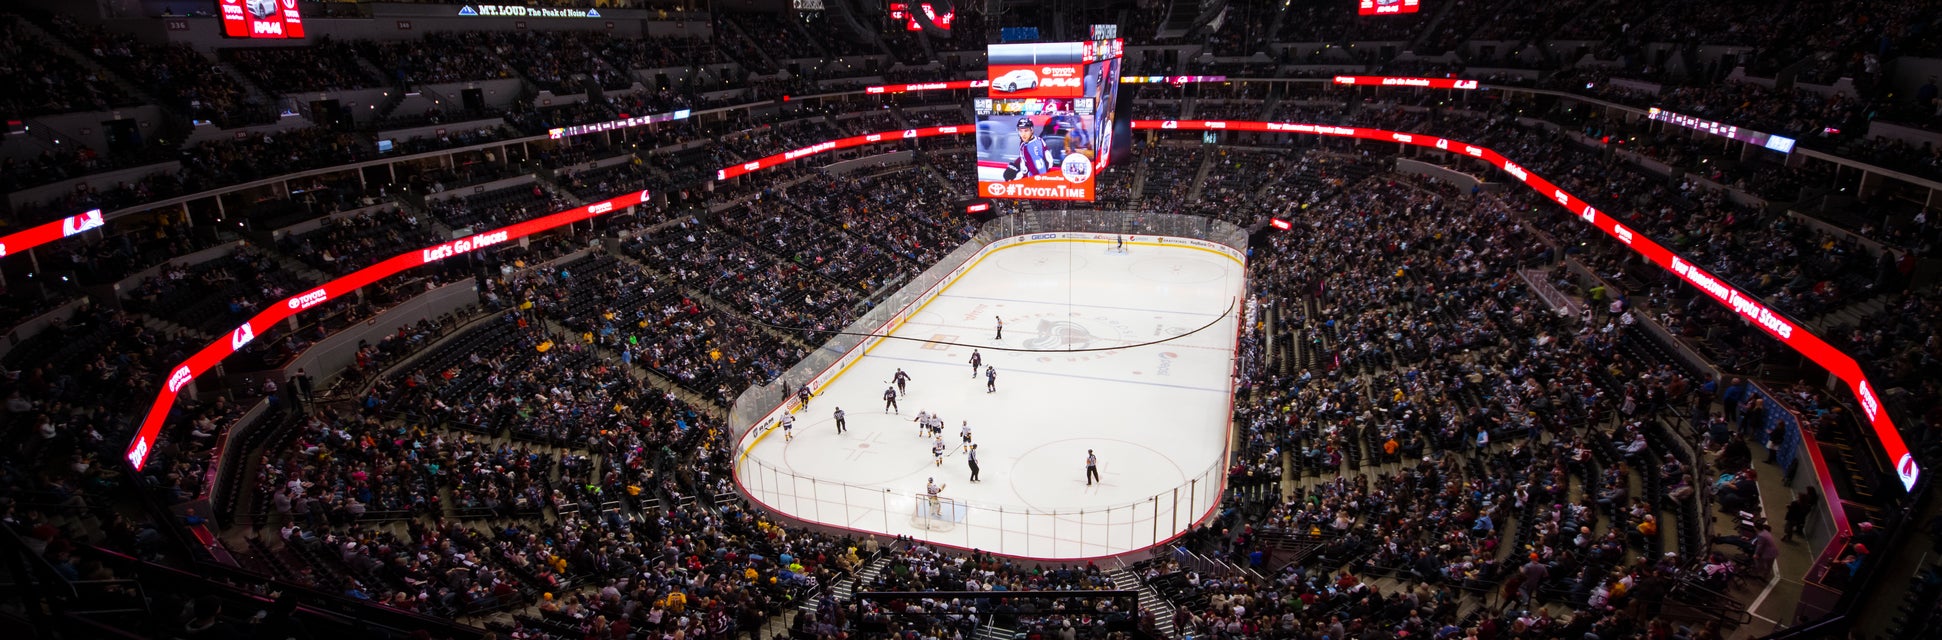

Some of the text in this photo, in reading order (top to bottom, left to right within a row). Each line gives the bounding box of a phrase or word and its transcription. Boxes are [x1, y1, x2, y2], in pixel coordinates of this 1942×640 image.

[478, 5, 499, 16] MT.
[500, 5, 526, 16] LOUD
[527, 8, 541, 16] The
[542, 8, 559, 17] Peak
[568, 9, 586, 17] Noise
[1031, 233, 1056, 241] GEICO
[423, 230, 508, 264] Let's Go Places
[299, 288, 327, 304] TOYOTA
[1671, 255, 1793, 339] Your Hometown Toyota Stores
[758, 417, 775, 432] RAM
